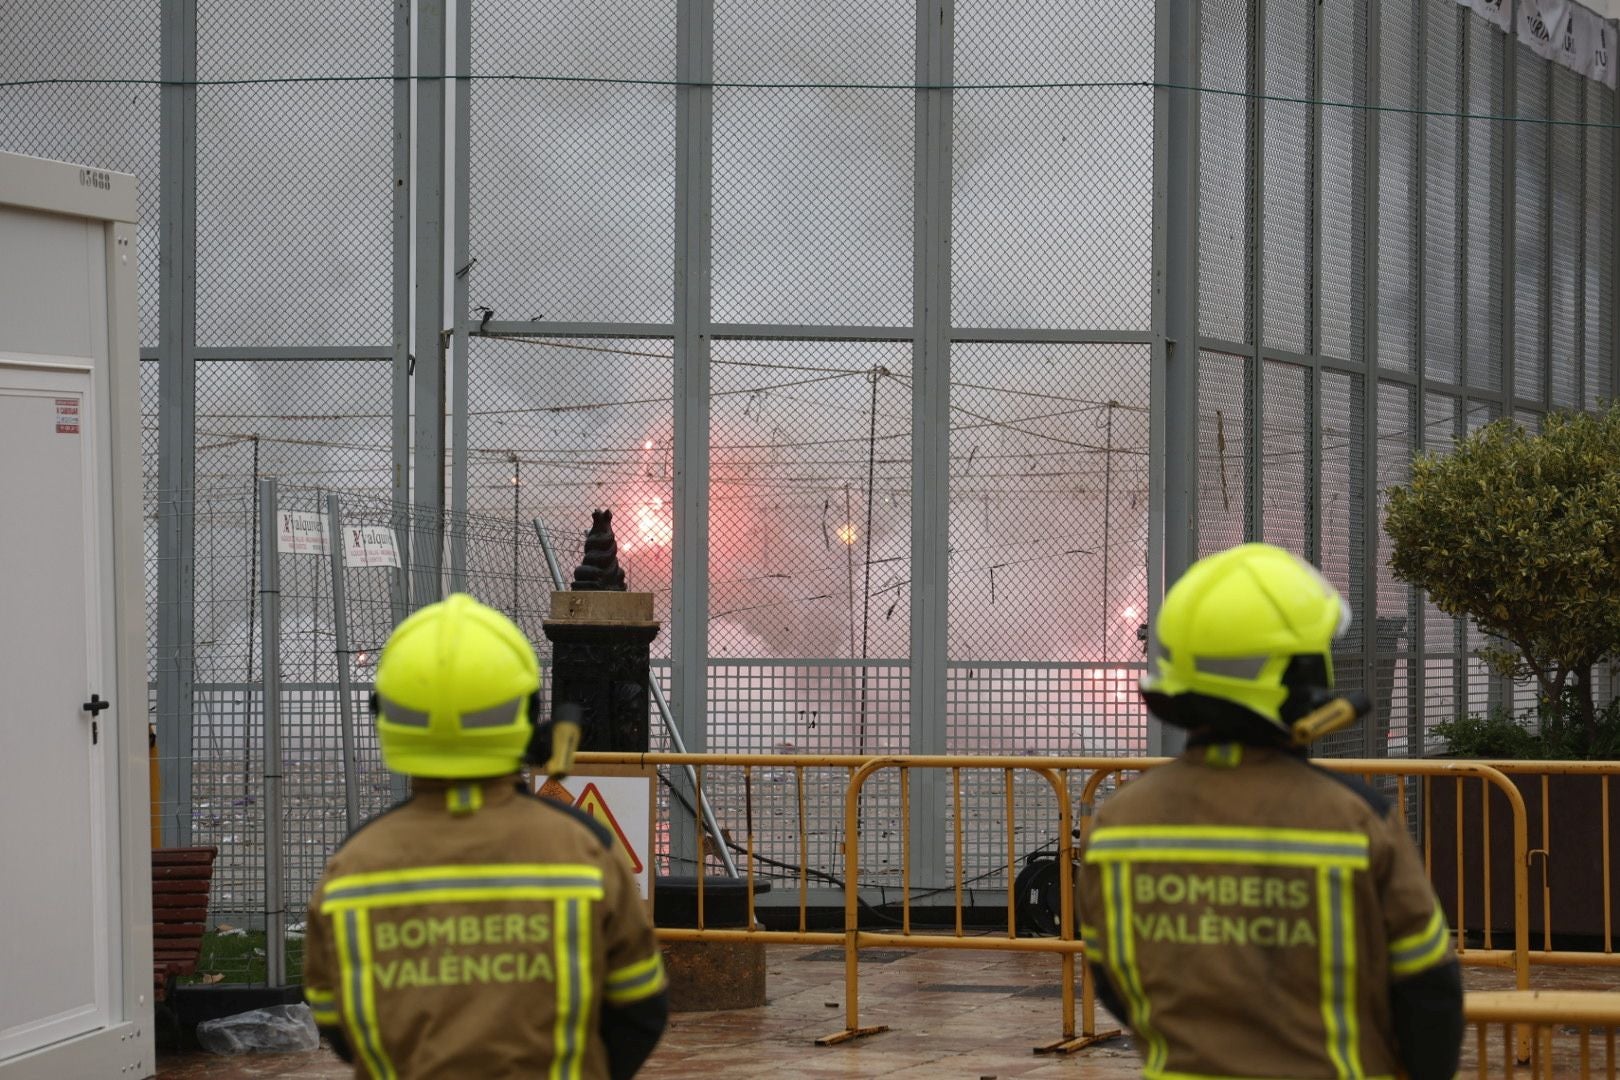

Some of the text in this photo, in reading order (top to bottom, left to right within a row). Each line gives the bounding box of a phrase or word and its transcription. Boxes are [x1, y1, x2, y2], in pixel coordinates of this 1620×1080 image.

[1134, 873, 1310, 910] BOMBERS
[375, 912, 550, 951] BOMBERS
[1133, 907, 1317, 947] VALÈNCIA
